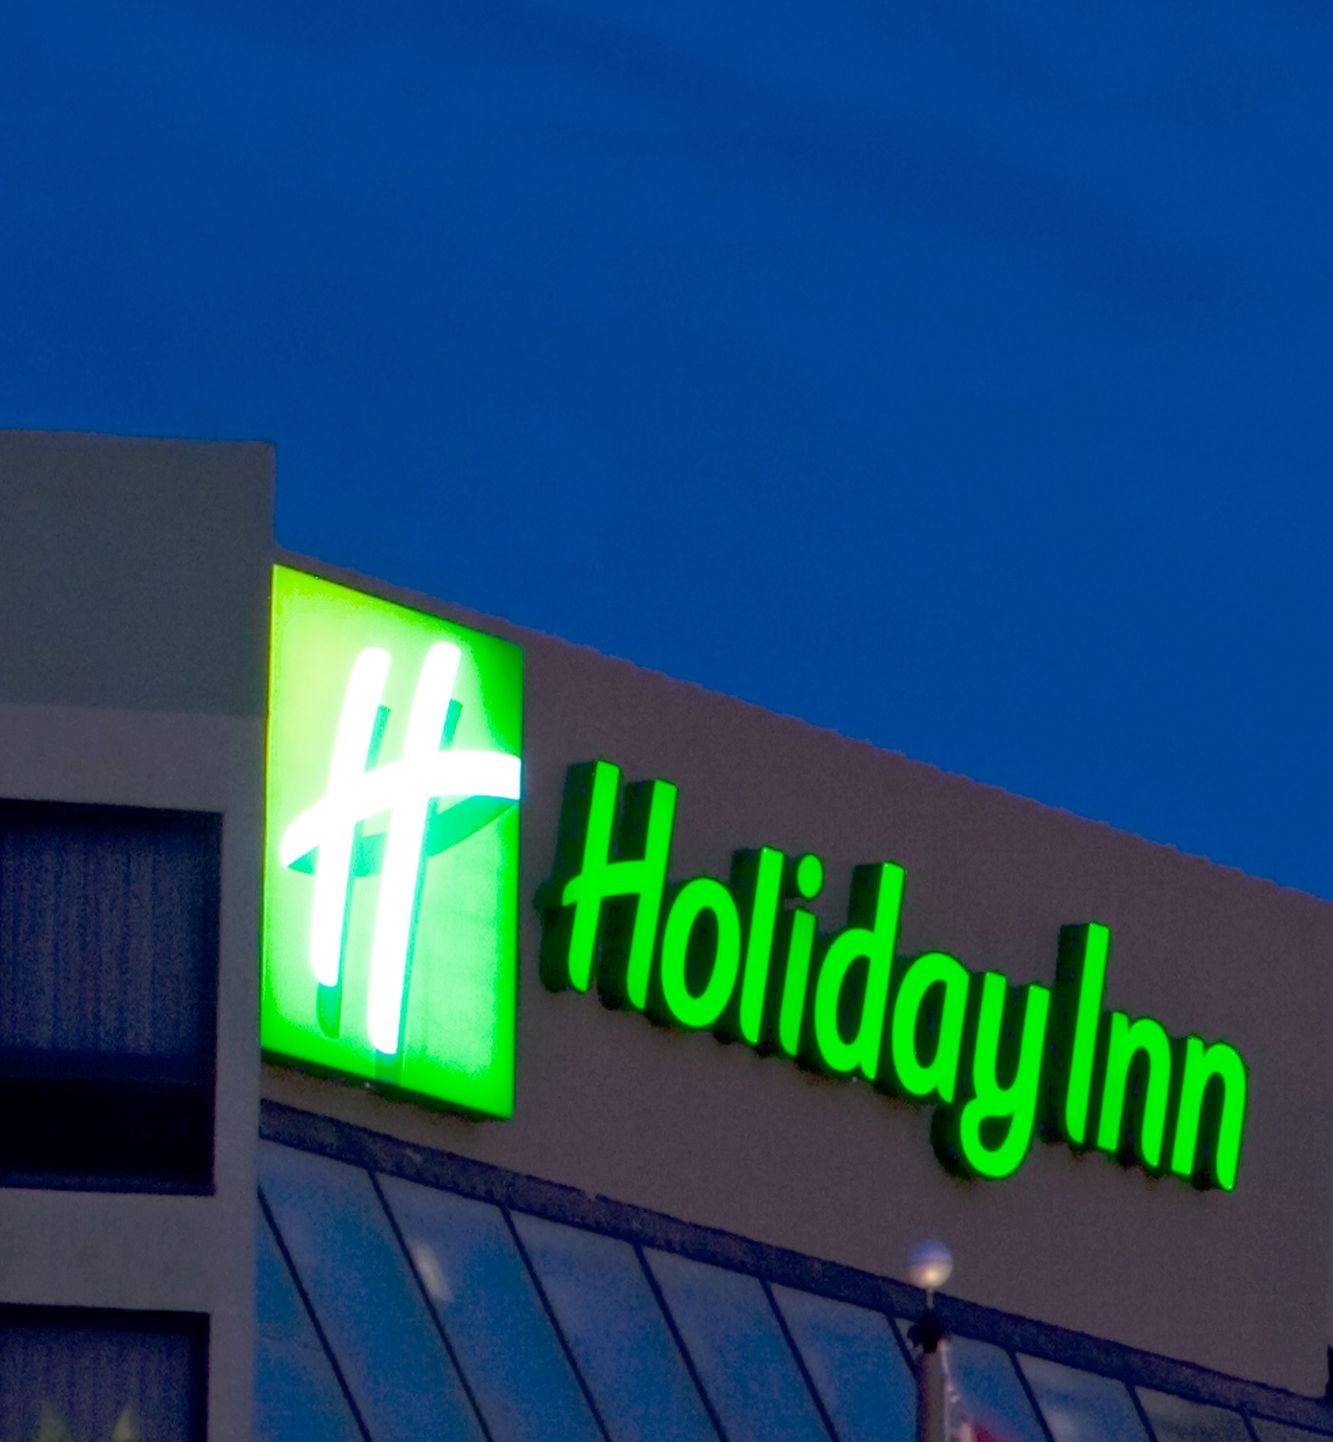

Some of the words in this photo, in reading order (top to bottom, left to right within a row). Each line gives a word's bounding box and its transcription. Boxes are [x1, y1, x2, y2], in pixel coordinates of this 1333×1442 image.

[279, 640, 522, 1055] H
[561, 759, 1052, 1178] Holiday
[1059, 922, 1247, 1191] Inn
